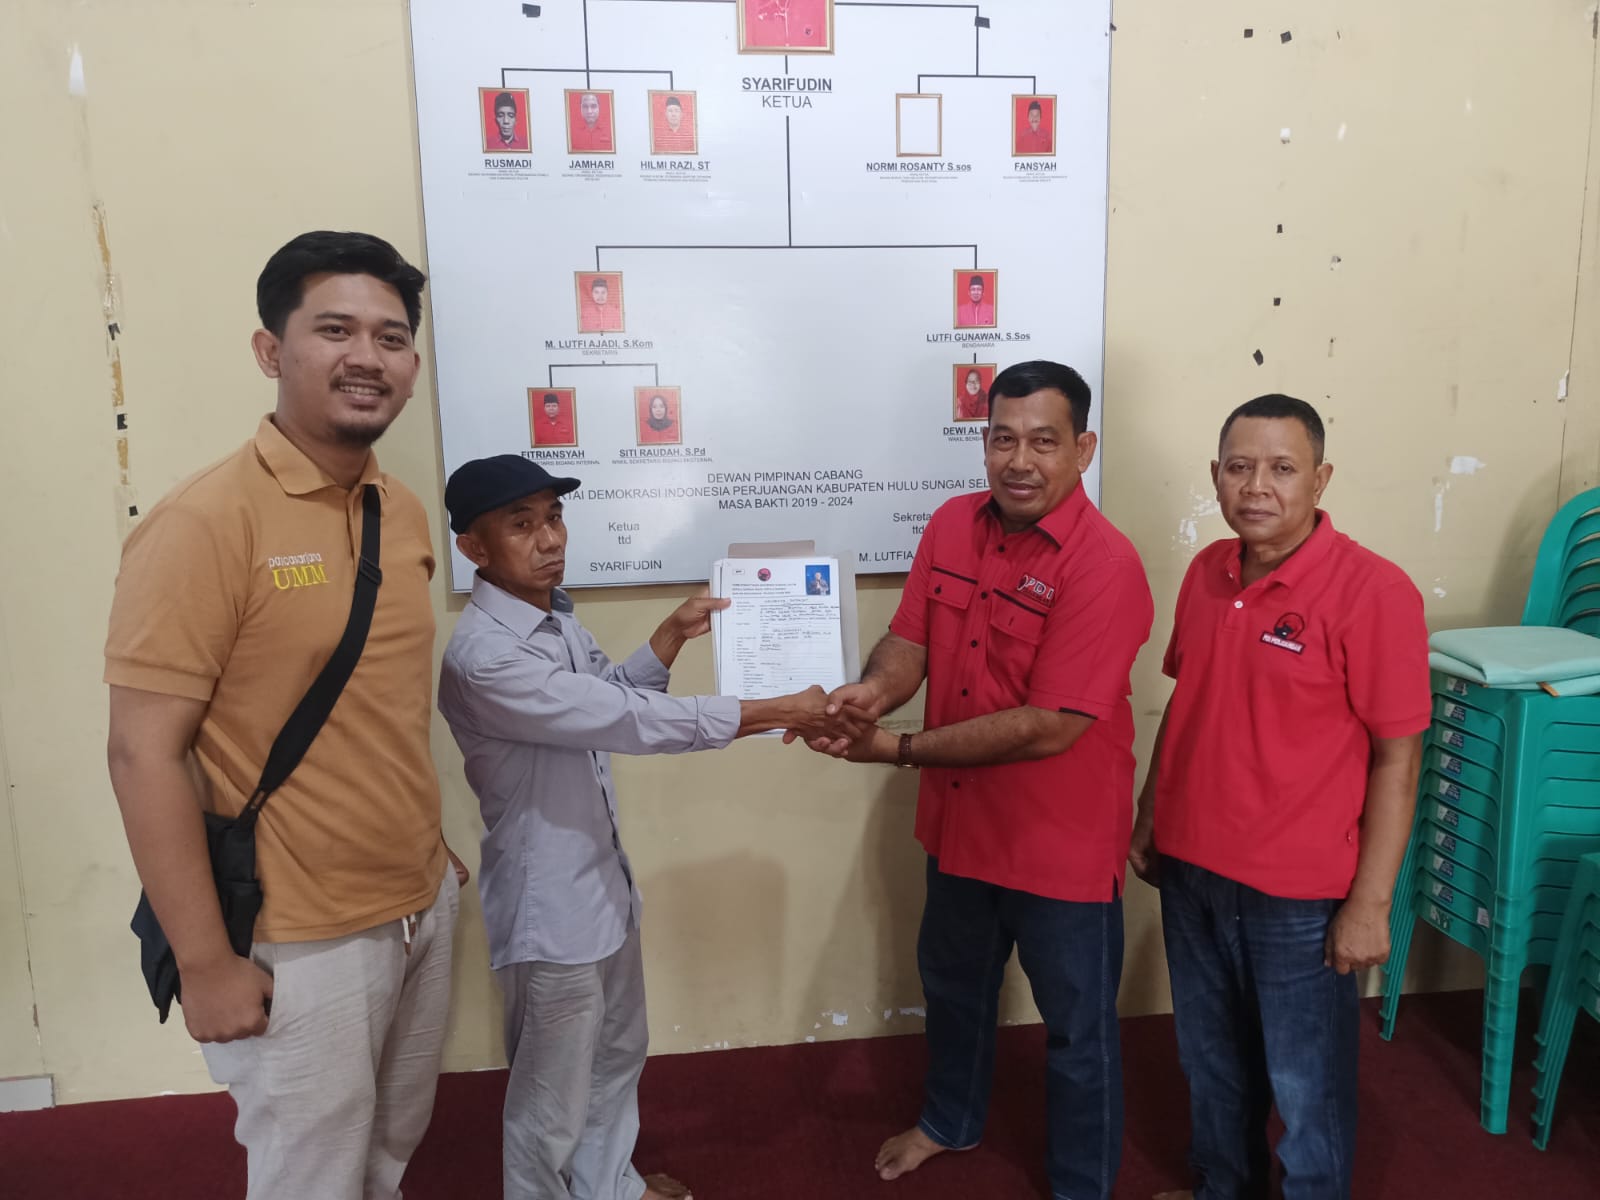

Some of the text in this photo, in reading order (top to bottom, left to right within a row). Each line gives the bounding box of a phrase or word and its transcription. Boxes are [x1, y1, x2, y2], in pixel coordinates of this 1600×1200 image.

[742, 77, 832, 91] SYARIFUDIN
[762, 95, 813, 108] KETUA
[484, 159, 532, 168] RUSMADI
[569, 160, 615, 169] JAMHARI
[640, 160, 710, 171] HILMI RAZI, ST
[866, 162, 898, 171] NORMI
[900, 162, 944, 171] ROSANTY
[1014, 162, 1057, 171] FANSYAH
[926, 333, 952, 342] LUTFI
[954, 332, 1003, 341] GUNAWAN,
[545, 340, 556, 348] M.
[559, 340, 587, 349] LUTFI
[943, 427, 966, 436] DEWI
[521, 450, 585, 459] FITRIANSYAH
[620, 447, 706, 457] SITI RAUDAH, S.Pd
[707, 469, 863, 483] DEWAN PIMPINAN CABANG
[588, 488, 661, 500] DEMOKRASI
[664, 486, 730, 497] INDONESIA
[733, 485, 813, 496] PERJUANGAN
[816, 482, 884, 494] KABUPATEN
[887, 481, 919, 491] HULU
[921, 479, 965, 490] SUNGAI
[968, 479, 992, 489] SEL
[718, 499, 752, 510] MASA
[754, 498, 789, 509] BAKTI
[791, 497, 818, 508] 2019
[827, 496, 853, 507] 2024
[892, 512, 932, 522] Sekreta
[608, 522, 640, 532] Ketua
[912, 525, 925, 535] ttd
[617, 535, 632, 545] ttd
[859, 553, 871, 562] M.
[590, 560, 662, 571] SYARIFUDIN
[272, 564, 331, 590] UMM
